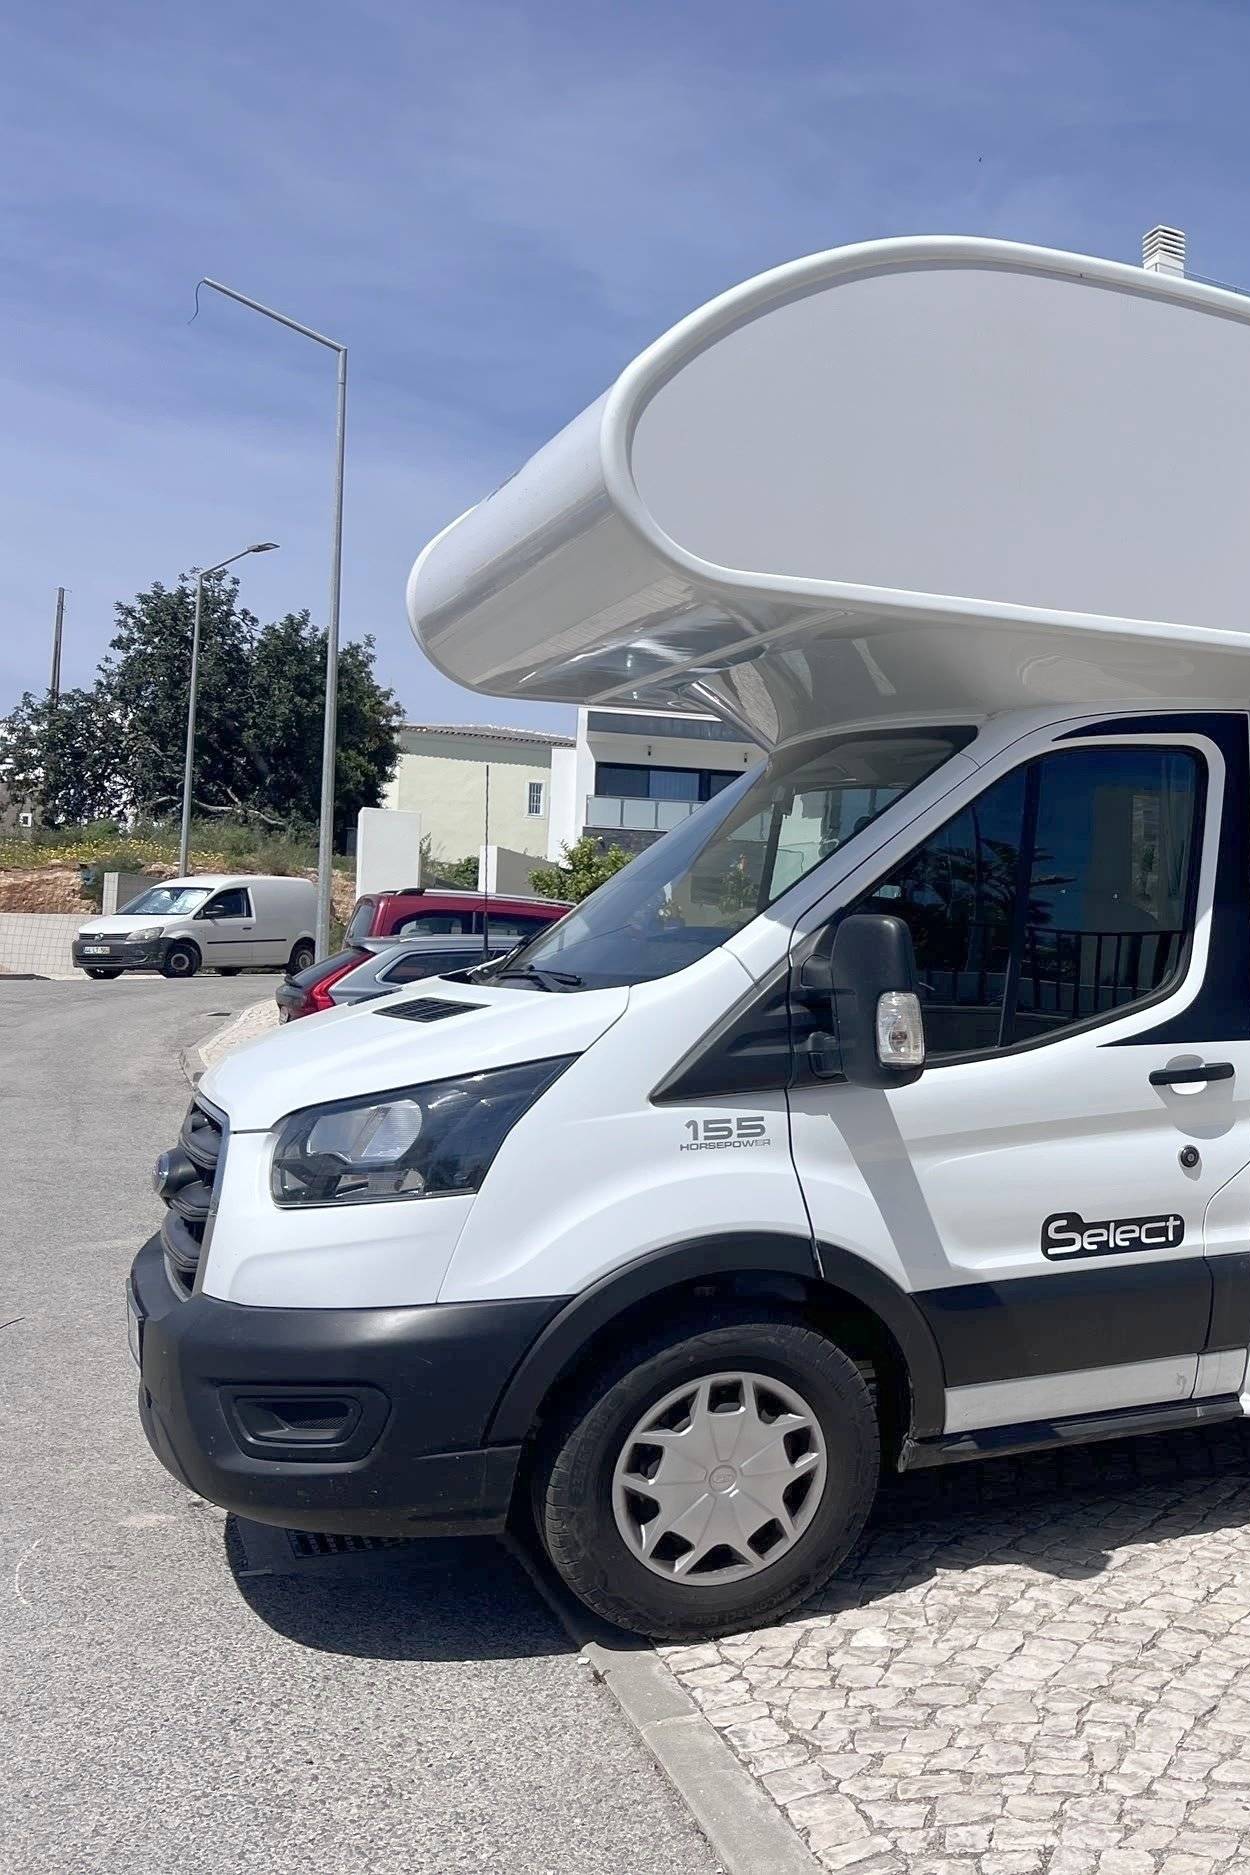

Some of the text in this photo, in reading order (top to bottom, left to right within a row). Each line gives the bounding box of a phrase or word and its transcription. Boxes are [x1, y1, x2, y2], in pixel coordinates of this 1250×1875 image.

[684, 1116, 767, 1141] 155
[680, 1139, 771, 1151] HORSEPOWER
[1047, 1216, 1181, 1255] Select
